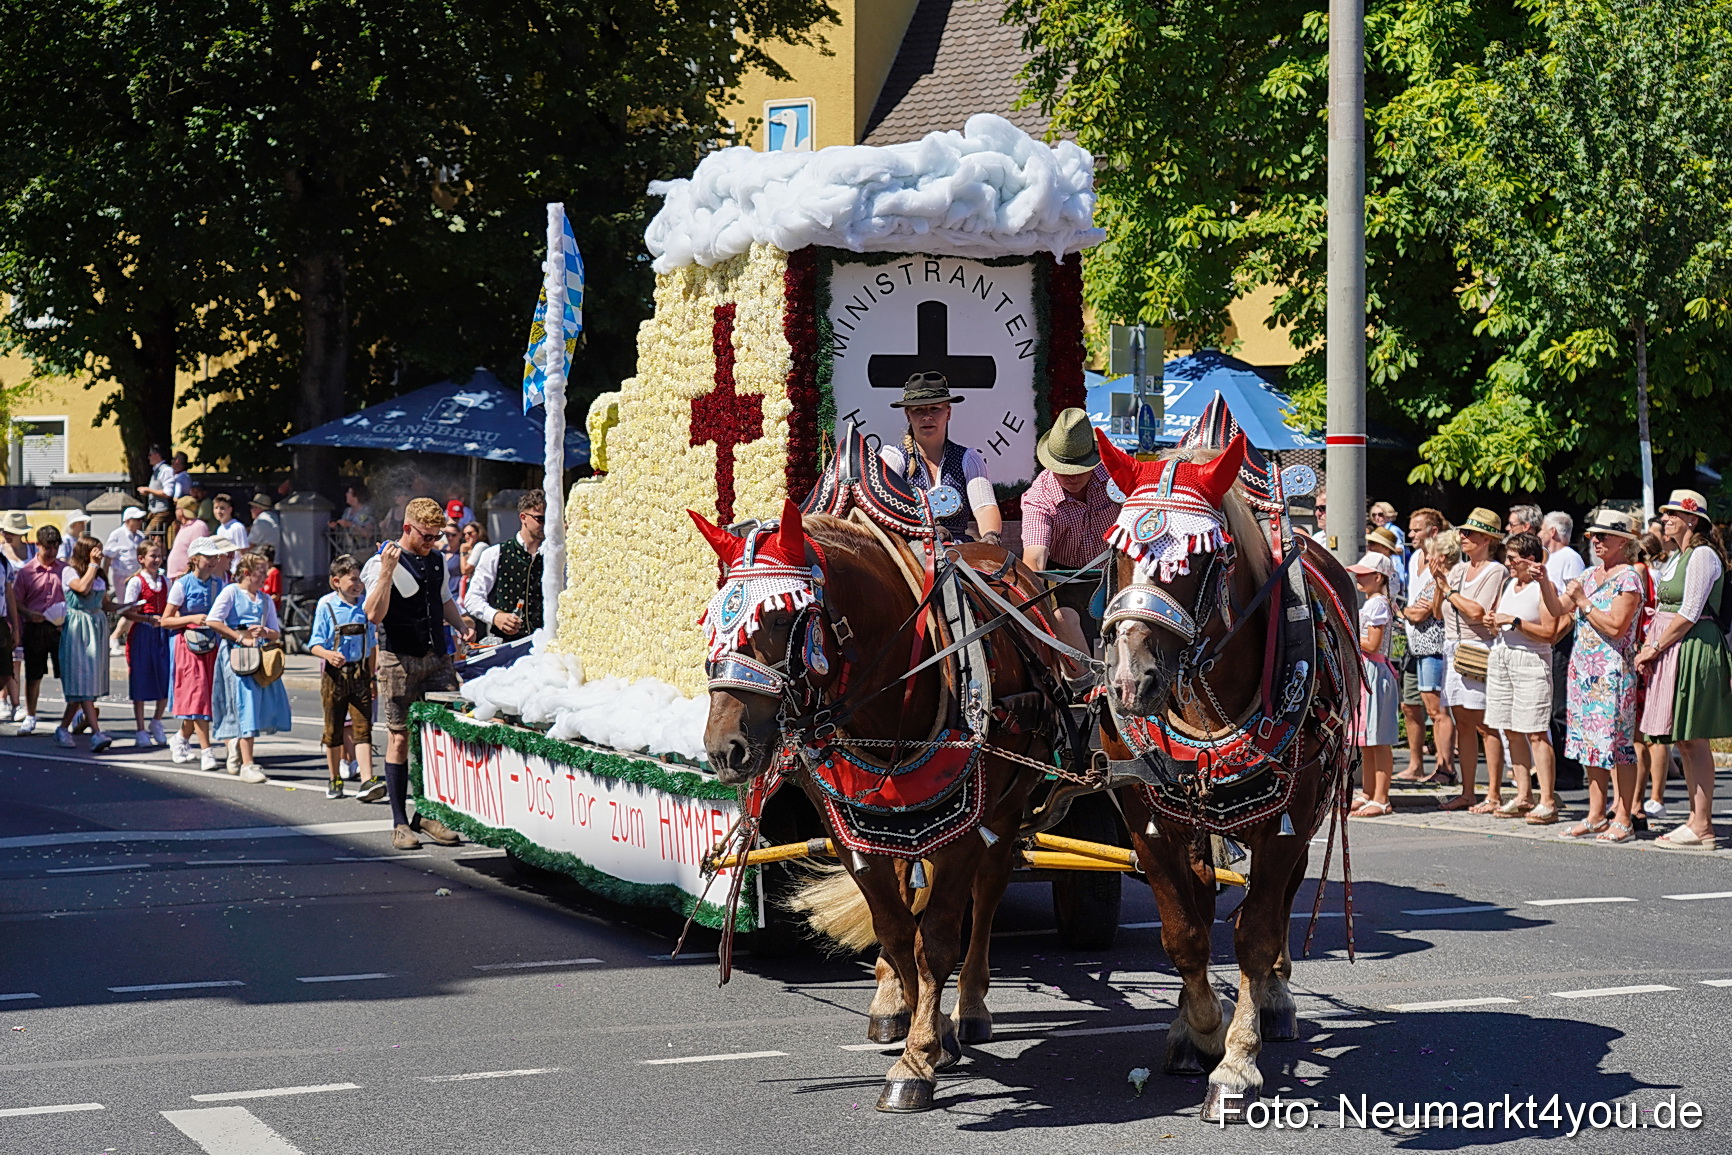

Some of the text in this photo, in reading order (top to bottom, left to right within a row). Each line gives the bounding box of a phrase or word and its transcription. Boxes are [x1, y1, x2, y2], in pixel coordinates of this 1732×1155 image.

[832, 260, 1036, 359] MINISTRANTEN
[423, 726, 505, 826] NEUMARKT
[524, 766, 555, 820] Das
[565, 774, 597, 829] Tor
[609, 801, 647, 849] zum
